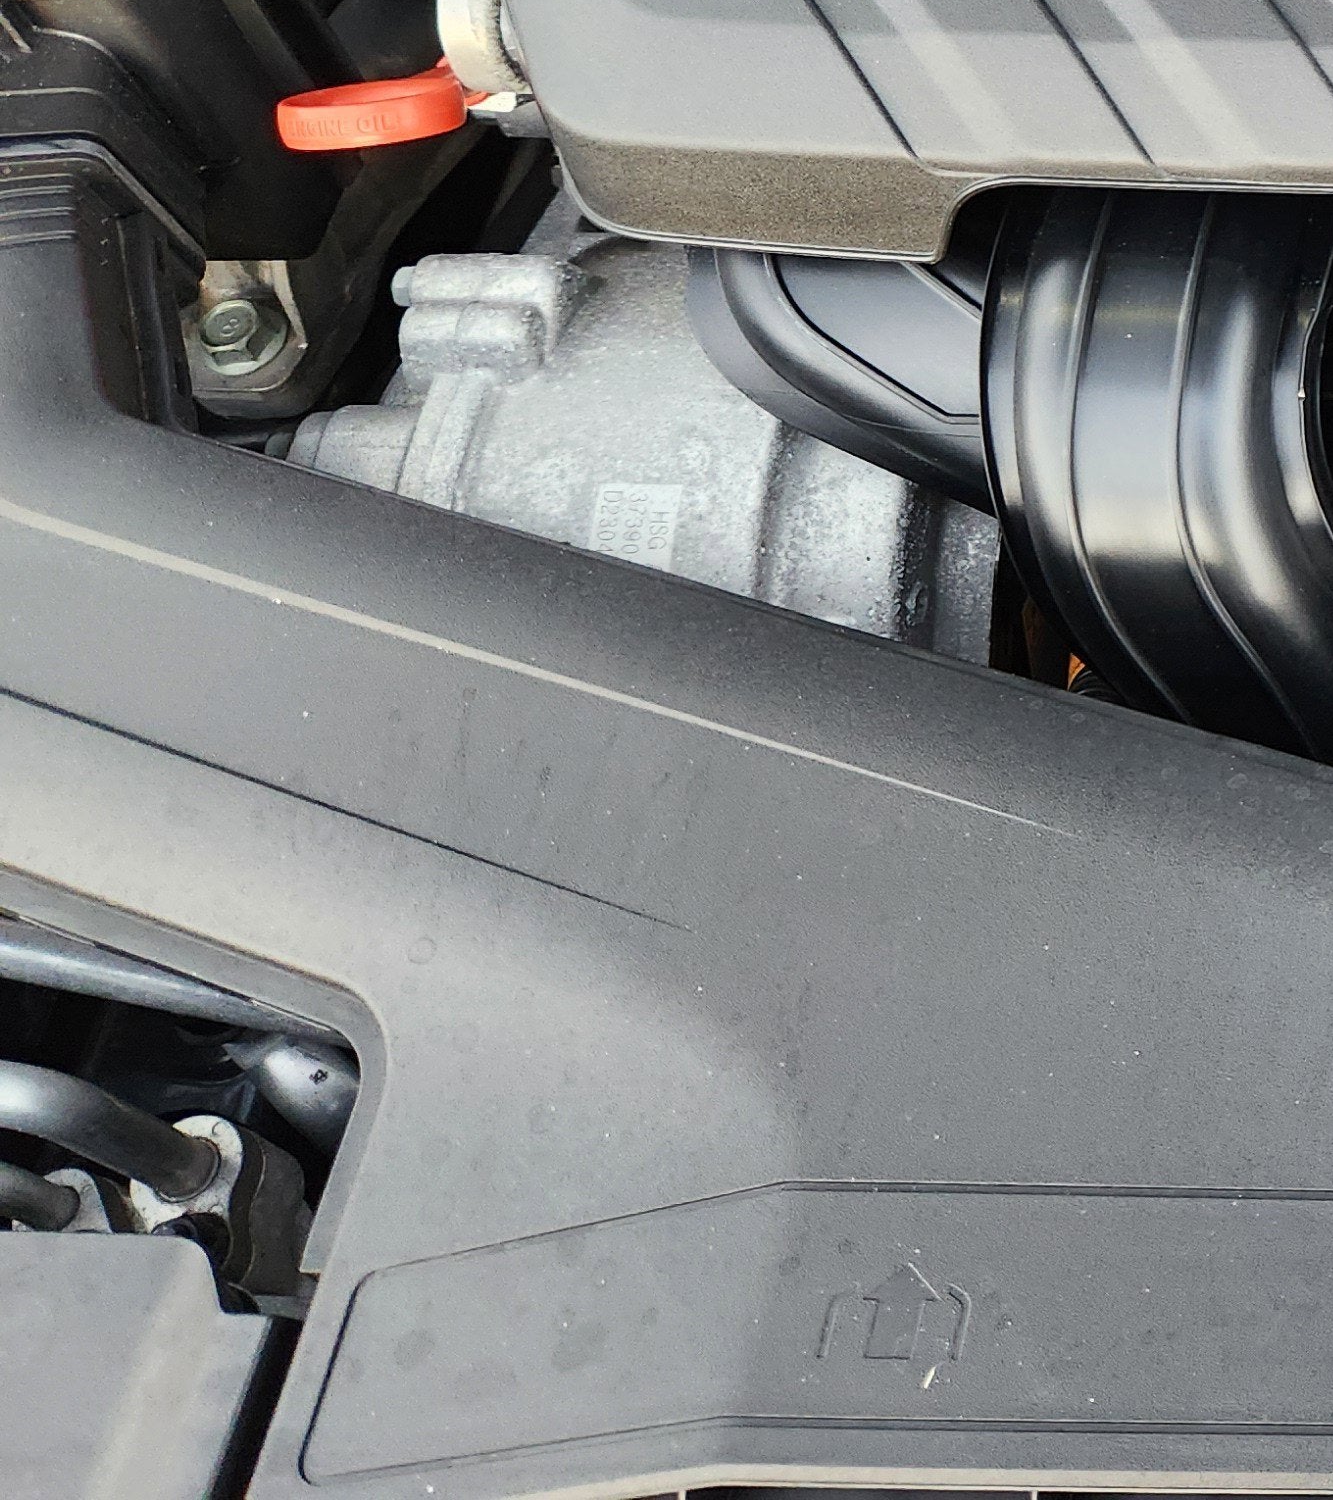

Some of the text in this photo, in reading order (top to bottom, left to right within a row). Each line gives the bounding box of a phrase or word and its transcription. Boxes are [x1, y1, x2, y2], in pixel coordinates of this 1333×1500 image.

[356, 113, 397, 134] OIL
[620, 492, 648, 554] 37390
[646, 511, 670, 550] HSG
